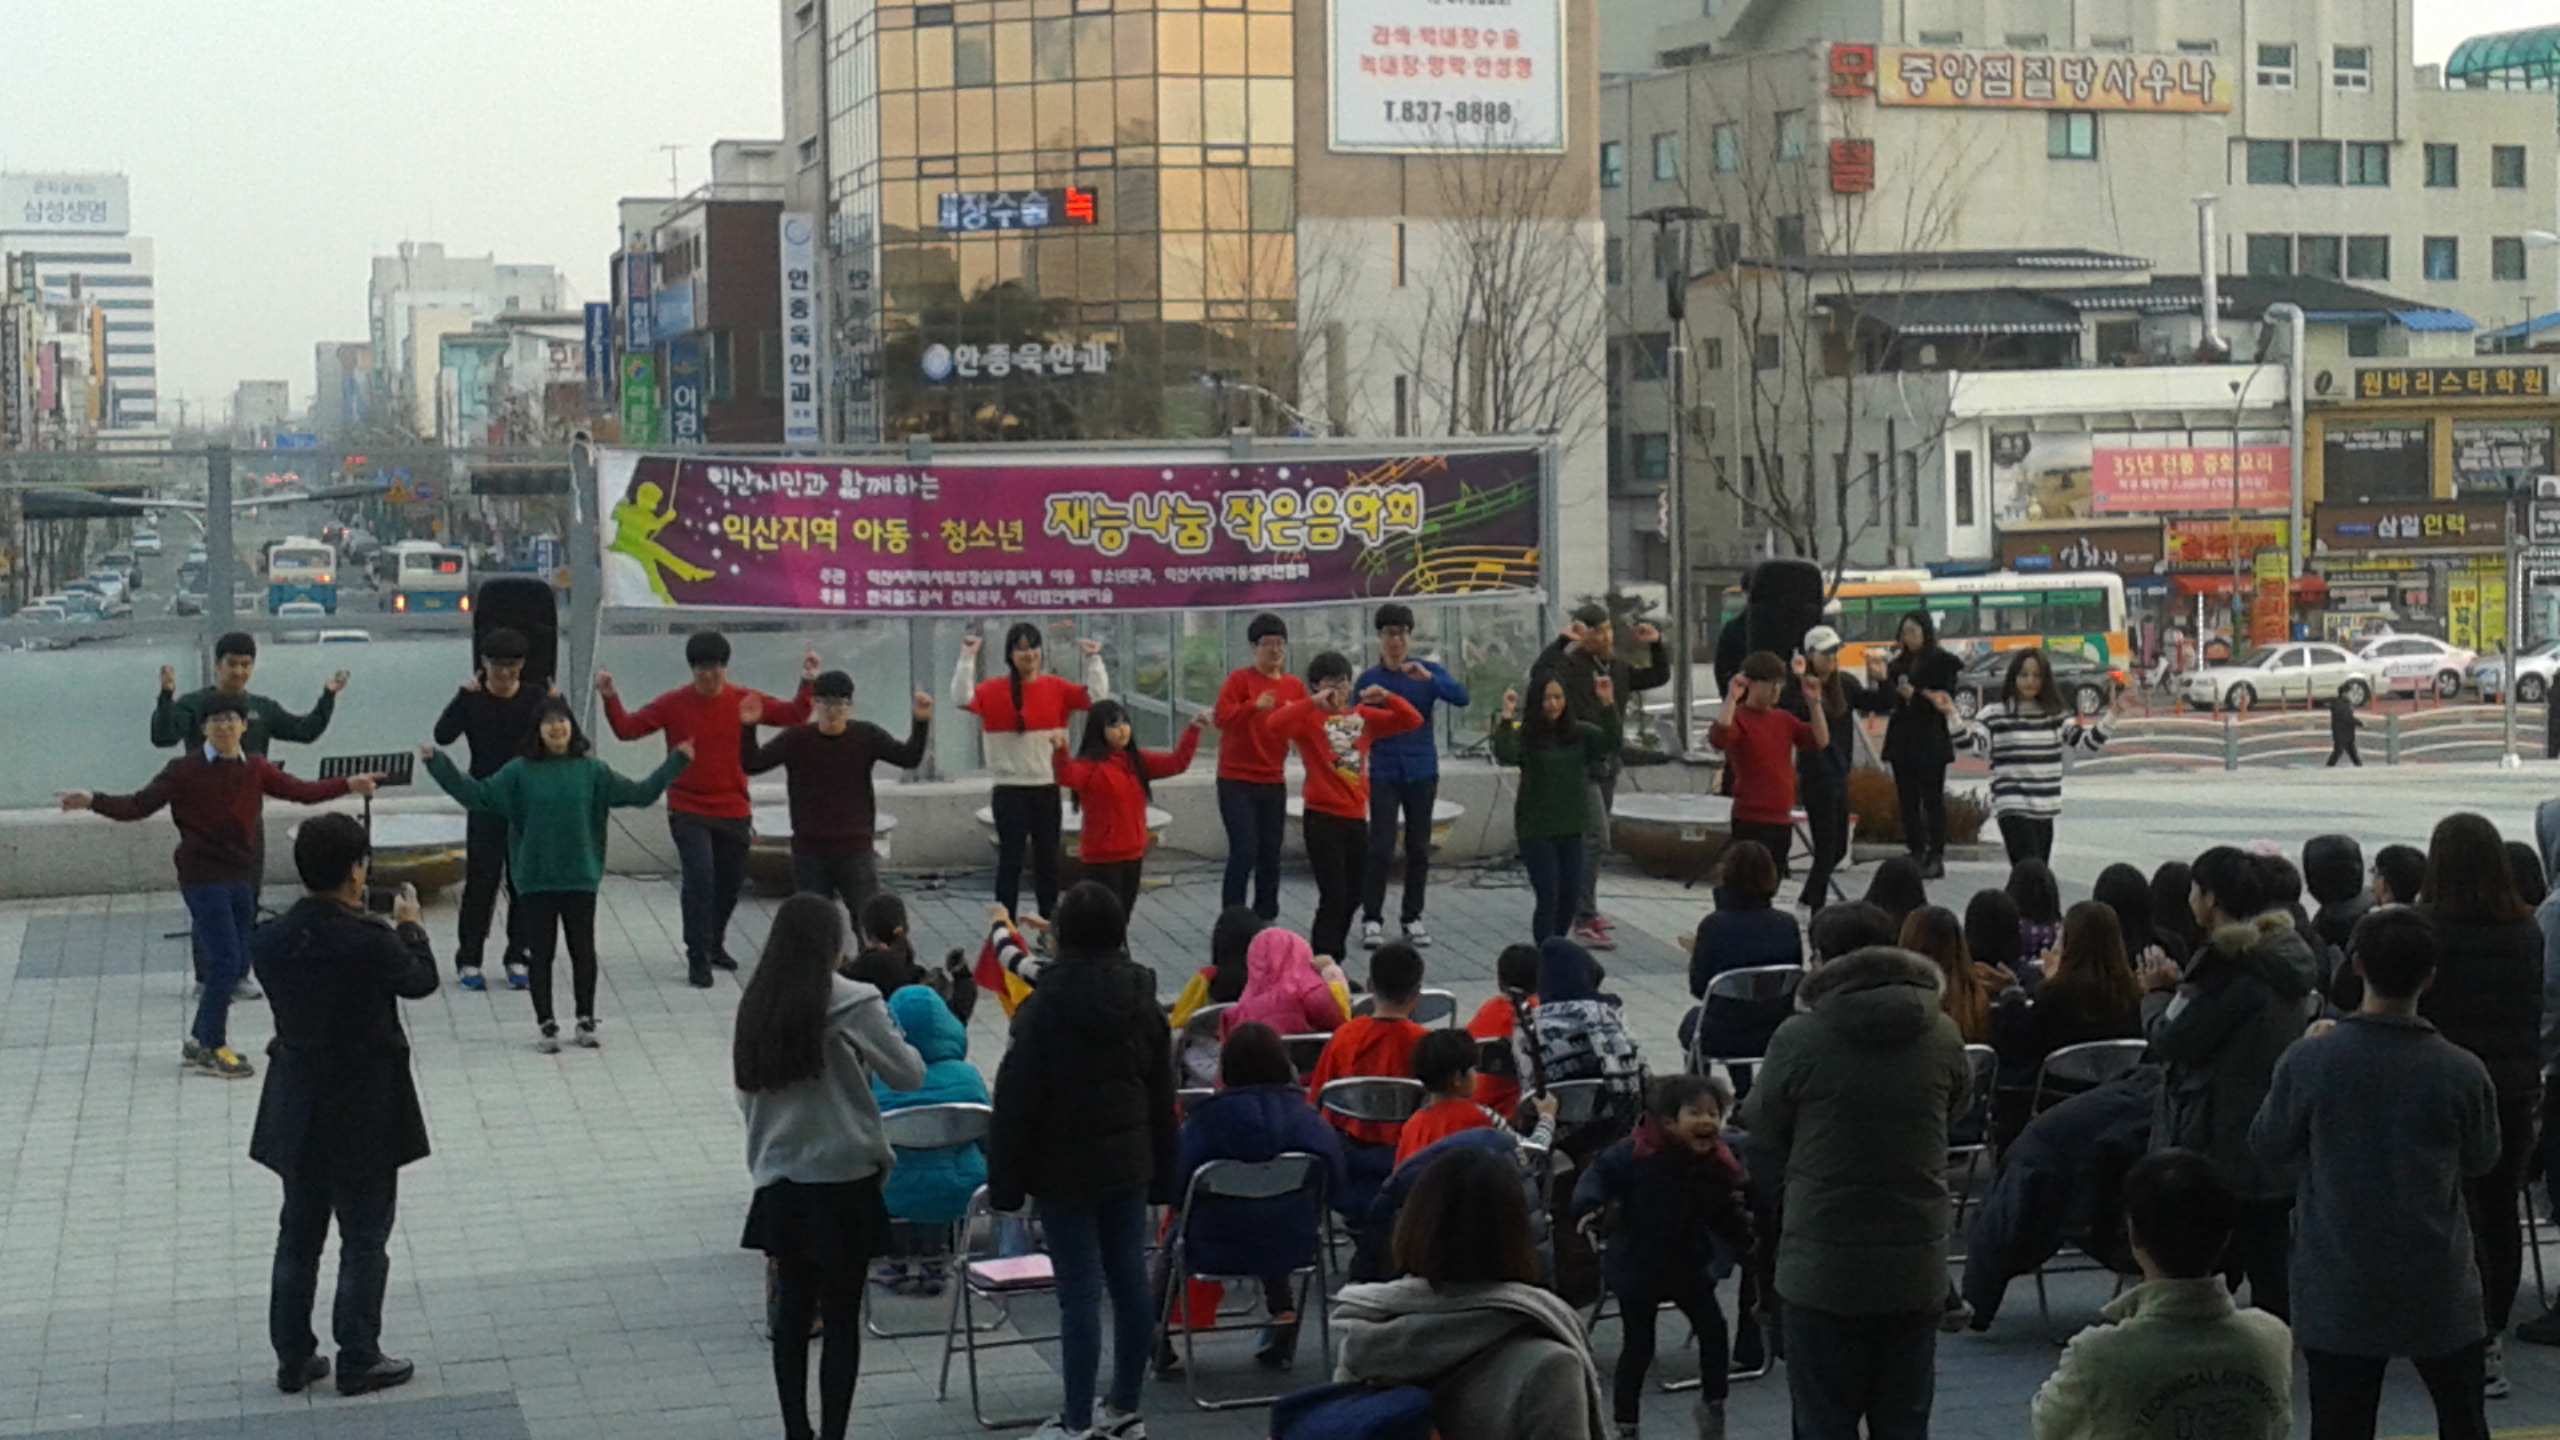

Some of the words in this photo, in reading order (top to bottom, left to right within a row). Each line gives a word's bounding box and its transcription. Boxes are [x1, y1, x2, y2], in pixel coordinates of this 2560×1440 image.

[1383, 100, 1511, 124] T.837-8888
[23, 200, 107, 222] 삼성생명
[954, 342, 1110, 377] 안종욱안과
[2362, 368, 2543, 396] 원바리스타학원
[2113, 454, 2154, 477] 35년
[707, 466, 829, 498] 익산시민과
[838, 467, 939, 500] 함께하는
[1046, 493, 1215, 554] 재능나눔
[1222, 484, 1423, 551] 작은음악회
[2378, 513, 2465, 539] 삼일인력
[722, 514, 837, 552] 익산지역
[853, 517, 911, 554] 아동
[940, 518, 1024, 554] 청소년
